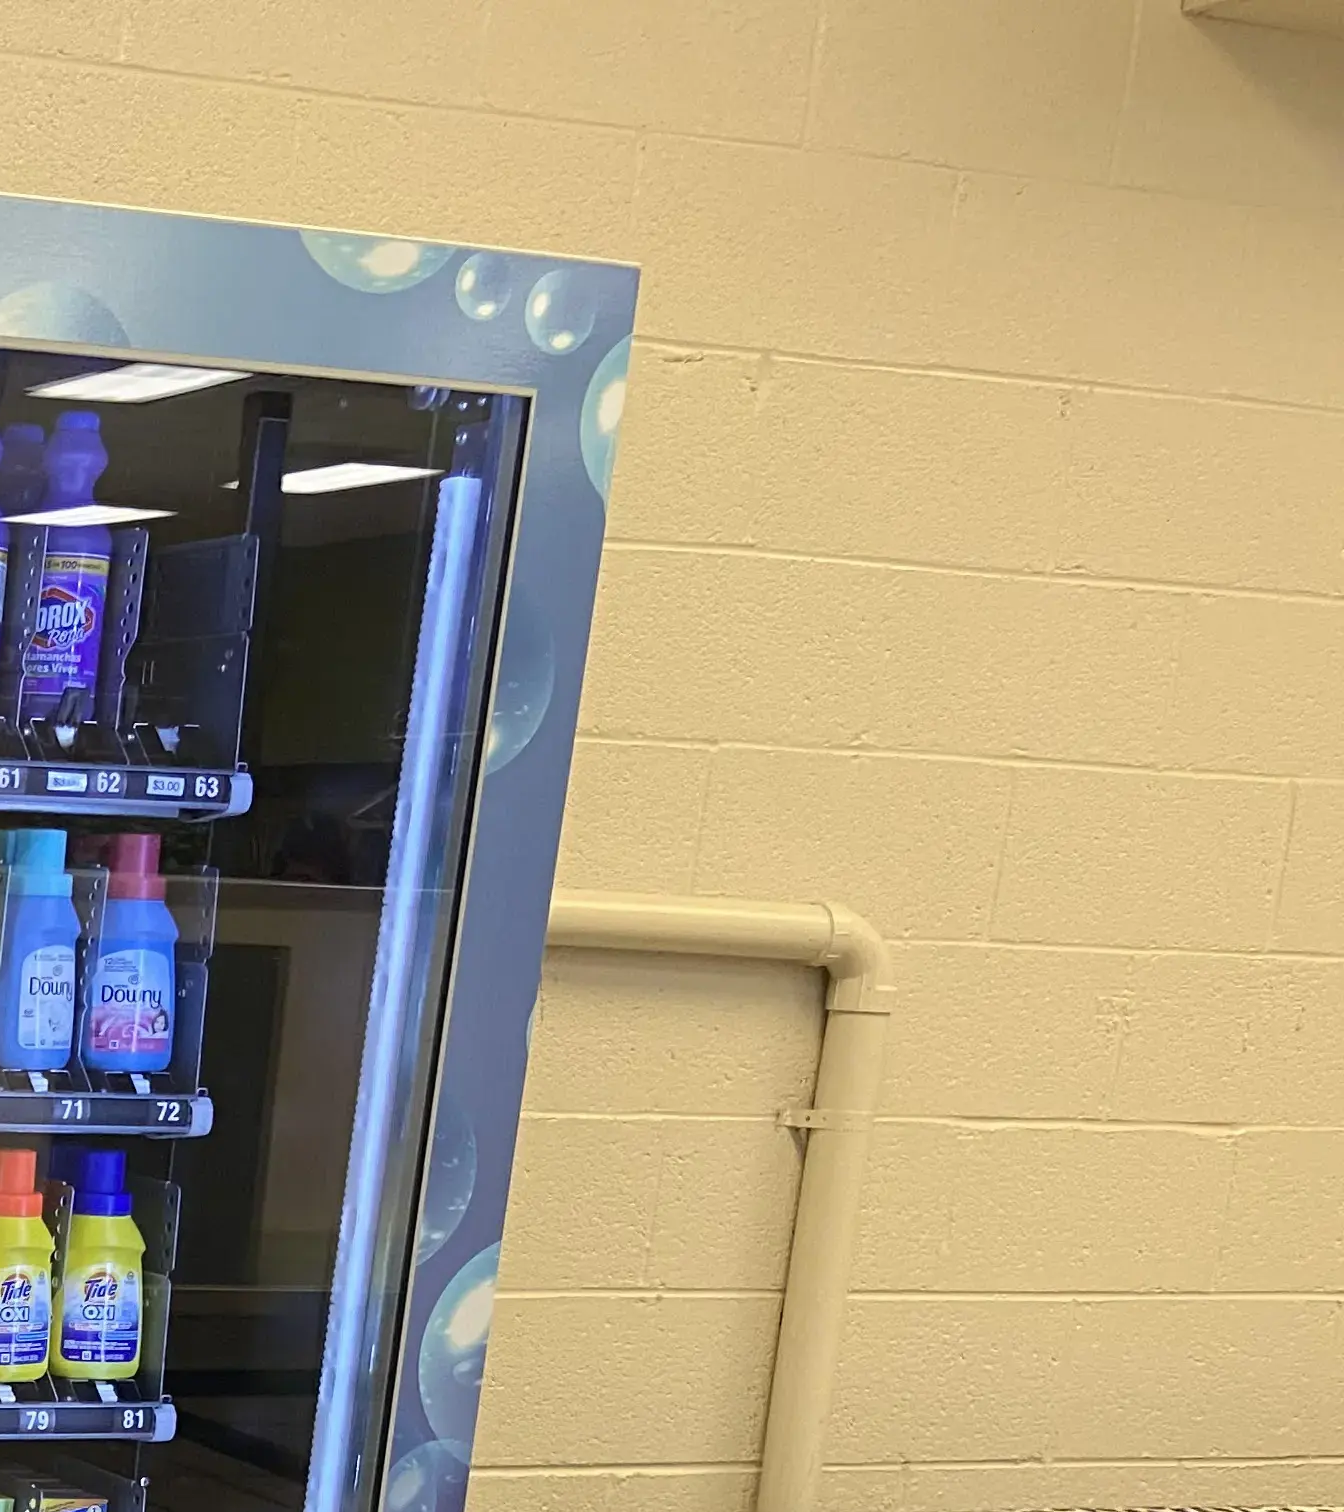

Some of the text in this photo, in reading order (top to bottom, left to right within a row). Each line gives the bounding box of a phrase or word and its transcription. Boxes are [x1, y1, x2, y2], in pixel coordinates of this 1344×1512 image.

[96, 772, 121, 793] 62
[194, 776, 219, 798] 63
[29, 976, 73, 1001] Downy
[100, 984, 162, 1008] Downy
[61, 1099, 84, 1120] 71
[156, 1101, 180, 1122] 72
[1, 1279, 32, 1304] Tide
[84, 1278, 117, 1302] Tide
[0, 1305, 30, 1322] OXI
[83, 1304, 115, 1320] OXI
[25, 1410, 50, 1431] 79
[122, 1409, 144, 1429] 81
